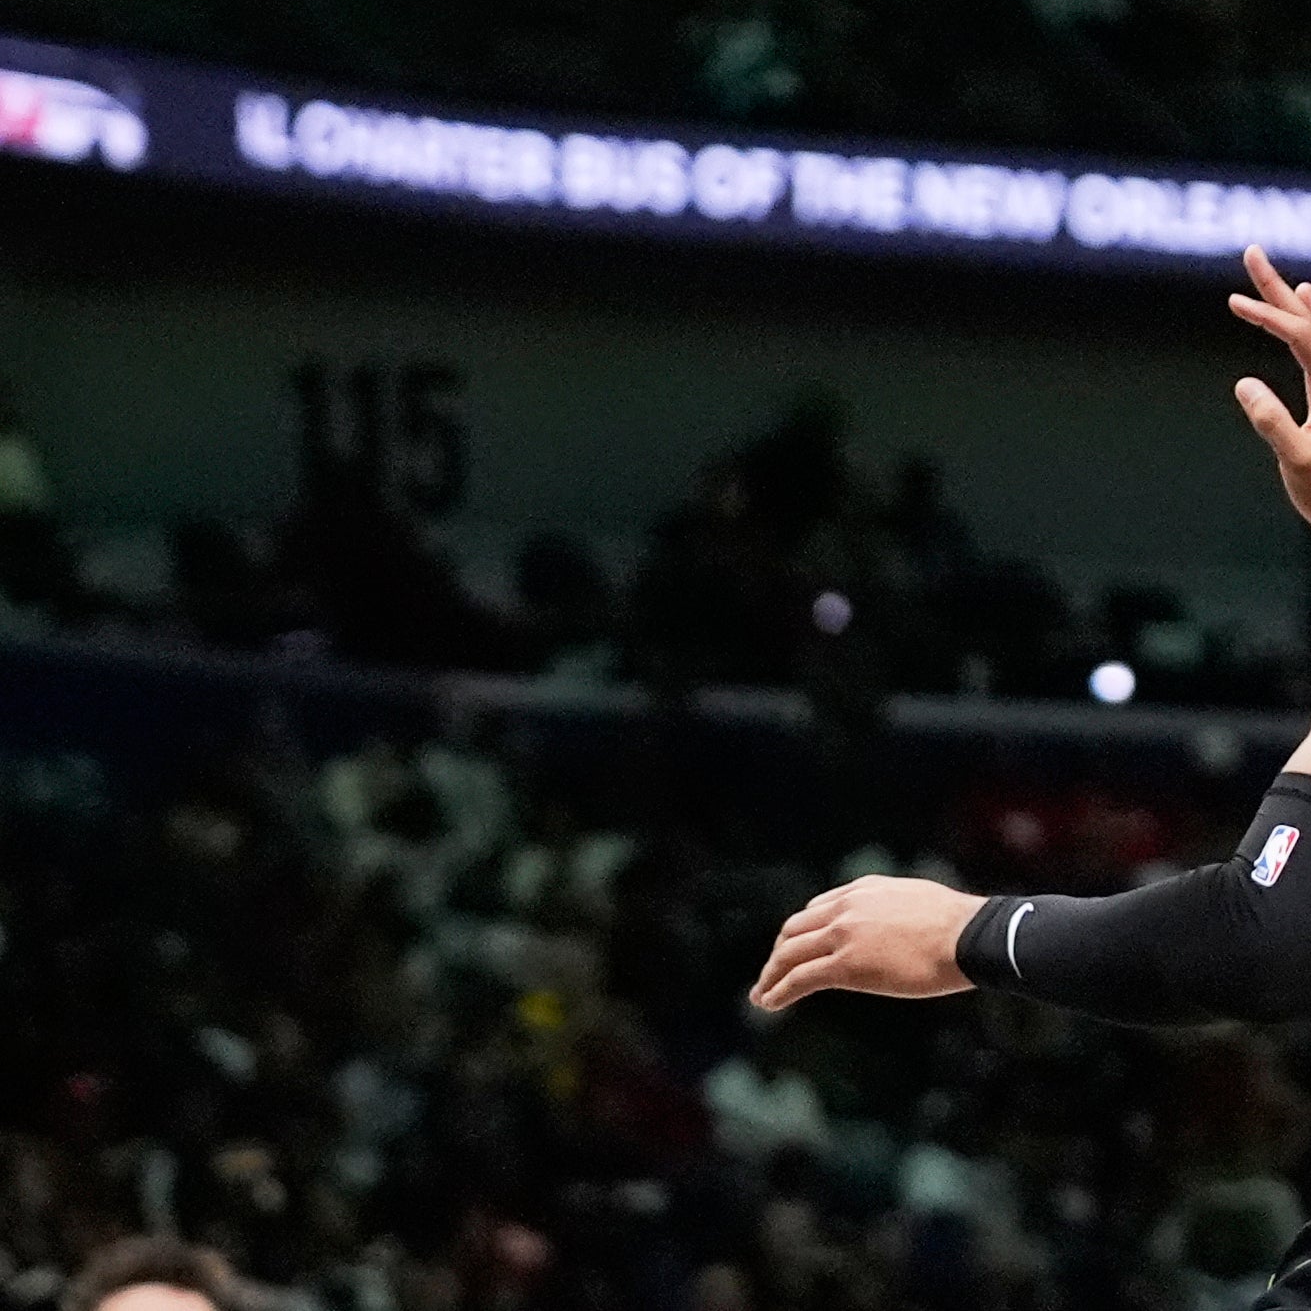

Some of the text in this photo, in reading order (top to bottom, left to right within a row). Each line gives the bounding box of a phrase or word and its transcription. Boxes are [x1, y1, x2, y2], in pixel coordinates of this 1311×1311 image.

[294, 103, 556, 201] CHARTER
[559, 134, 688, 213] BUS
[692, 145, 783, 218] OF
[791, 152, 906, 231] THE
[912, 163, 1064, 239] NEW
